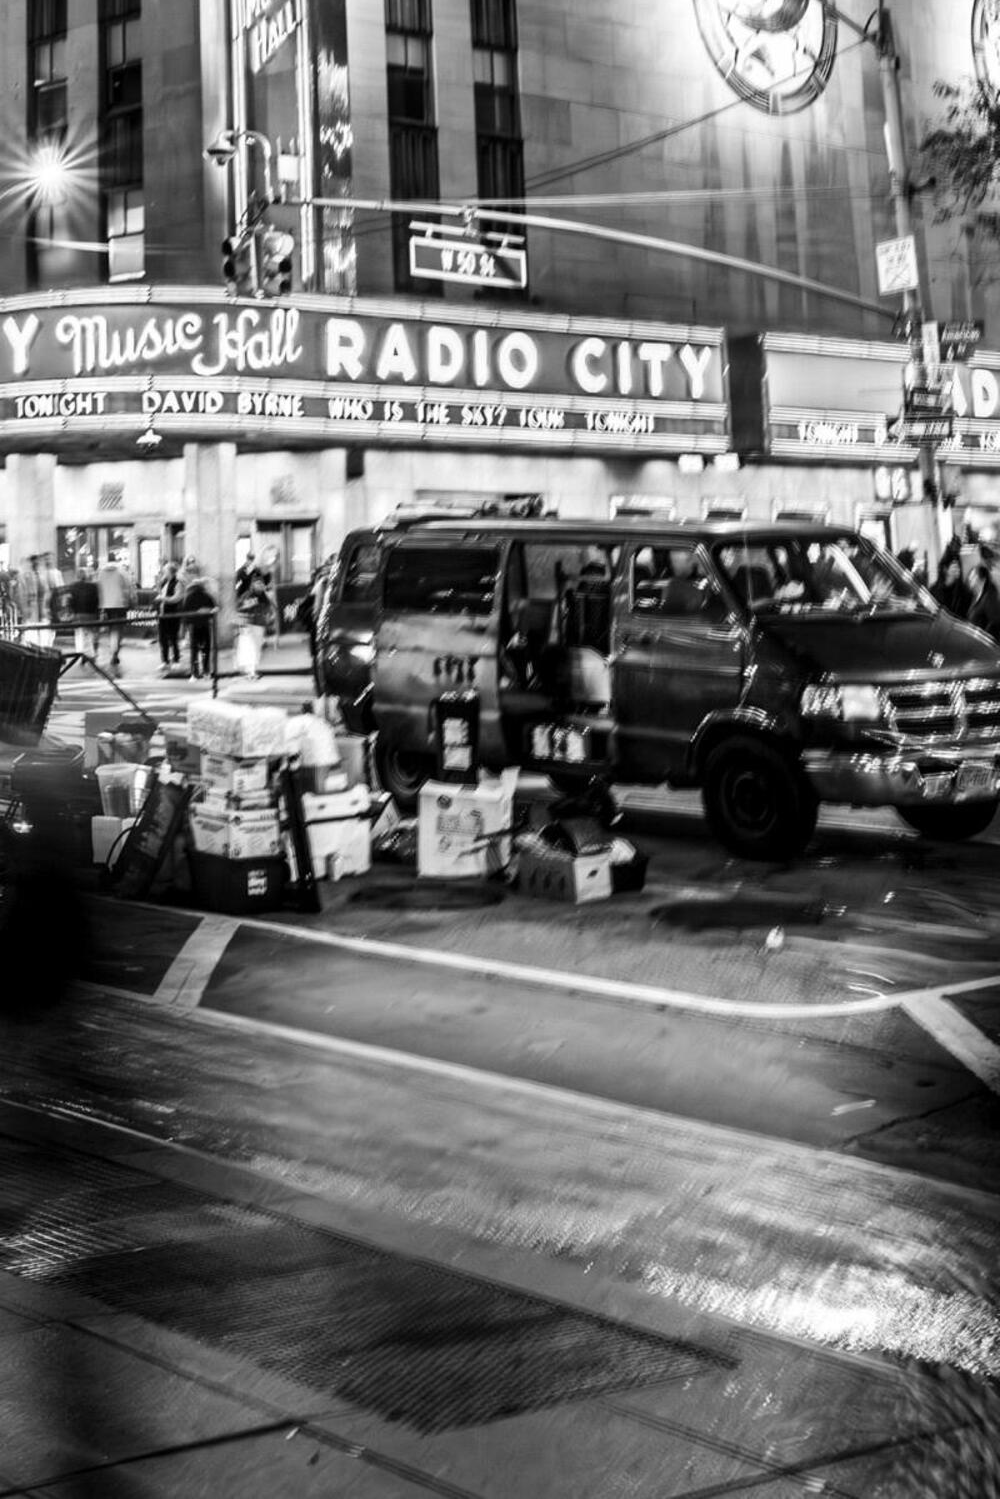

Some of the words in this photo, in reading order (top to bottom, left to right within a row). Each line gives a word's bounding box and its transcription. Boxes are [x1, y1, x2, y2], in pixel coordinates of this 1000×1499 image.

[55, 313, 202, 376] Music
[191, 307, 303, 377] Hall
[324, 317, 538, 389] RADIO
[572, 337, 712, 399] CITY
[16, 392, 107, 418] TONIGHT
[142, 390, 224, 413] DAVID
[237, 392, 304, 417] BYRNE
[328, 397, 373, 420] WHO
[384, 401, 404, 421] IS
[415, 402, 450, 424] THE
[461, 404, 507, 426] SKY?
